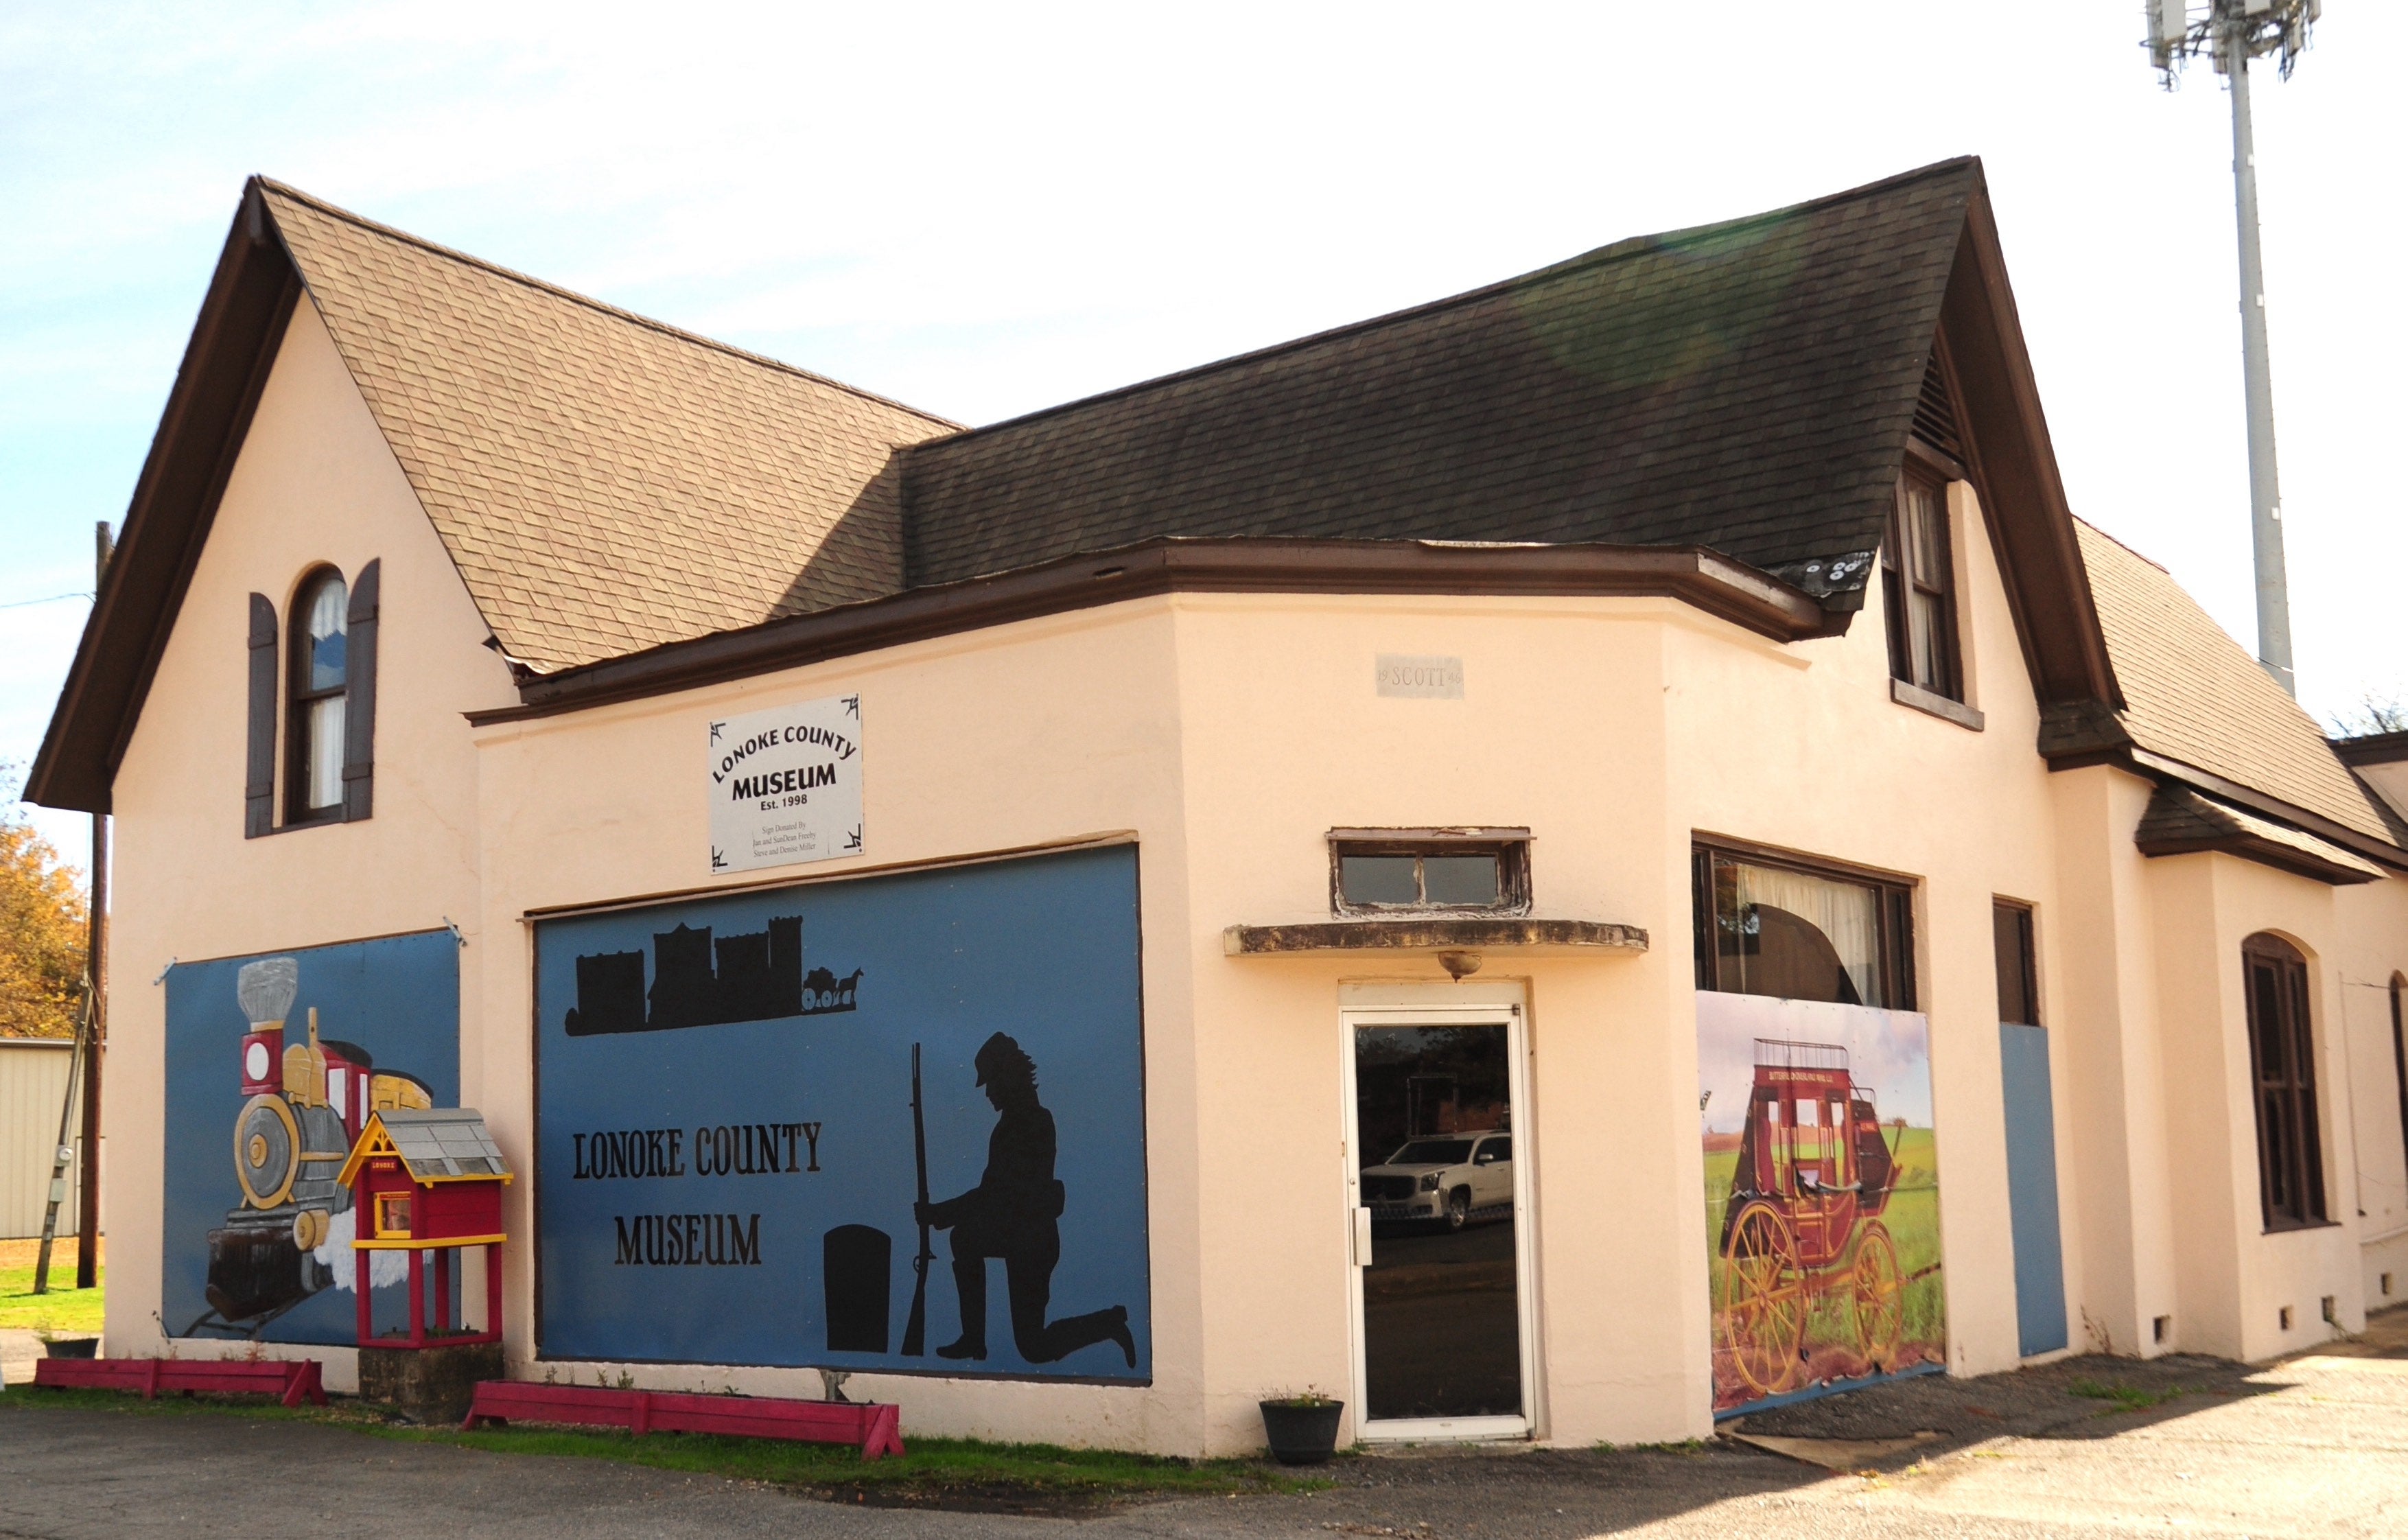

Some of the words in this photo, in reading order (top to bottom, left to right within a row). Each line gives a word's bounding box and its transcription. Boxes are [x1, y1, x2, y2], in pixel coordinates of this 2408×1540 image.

[1392, 666, 1446, 686] SCOTT
[712, 729, 780, 784] LONOKE
[784, 725, 856, 760] COUNTY
[732, 762, 837, 801] MUSEUM
[760, 800, 779, 811] Est.
[782, 794, 808, 808] 1998
[762, 826, 774, 835] Sign
[775, 821, 797, 832] Donated
[798, 821, 806, 830] By
[753, 850, 768, 858] Steve
[769, 847, 779, 855] and
[799, 842, 817, 851] Miller
[762, 837, 772, 845] and
[572, 1129, 685, 1179] LONOKE
[695, 1122, 822, 1176] COUNTY
[614, 1213, 762, 1265] MUSEUM
